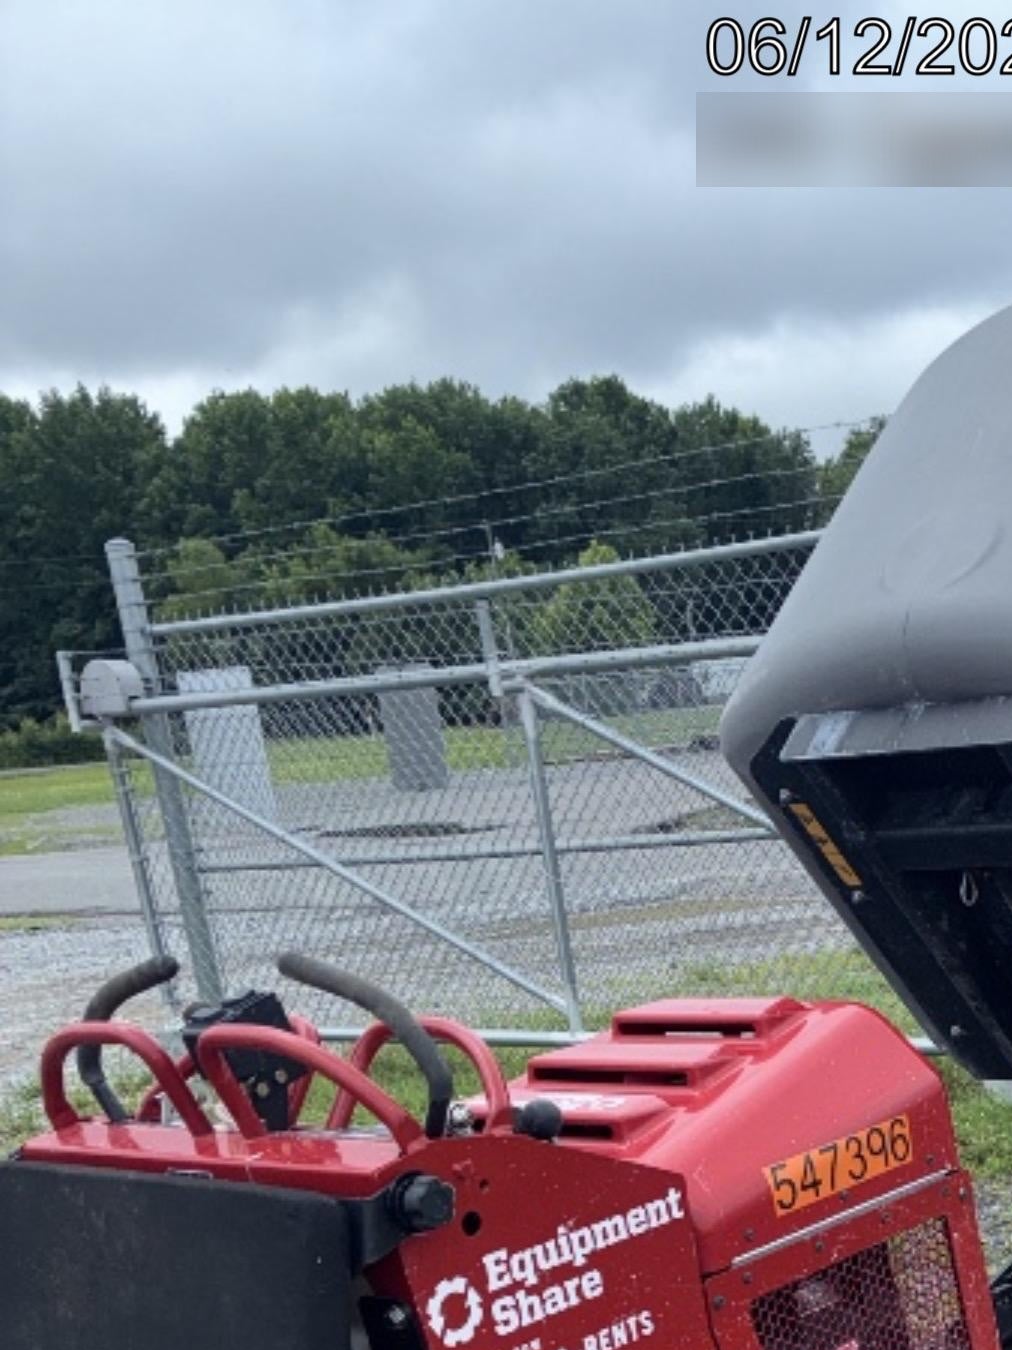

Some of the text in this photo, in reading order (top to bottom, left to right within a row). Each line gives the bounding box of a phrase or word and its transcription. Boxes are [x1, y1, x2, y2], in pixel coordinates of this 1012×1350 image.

[770, 1118, 910, 1210] 547396
[482, 1187, 684, 1292] Equipment
[491, 1269, 604, 1336] Share
